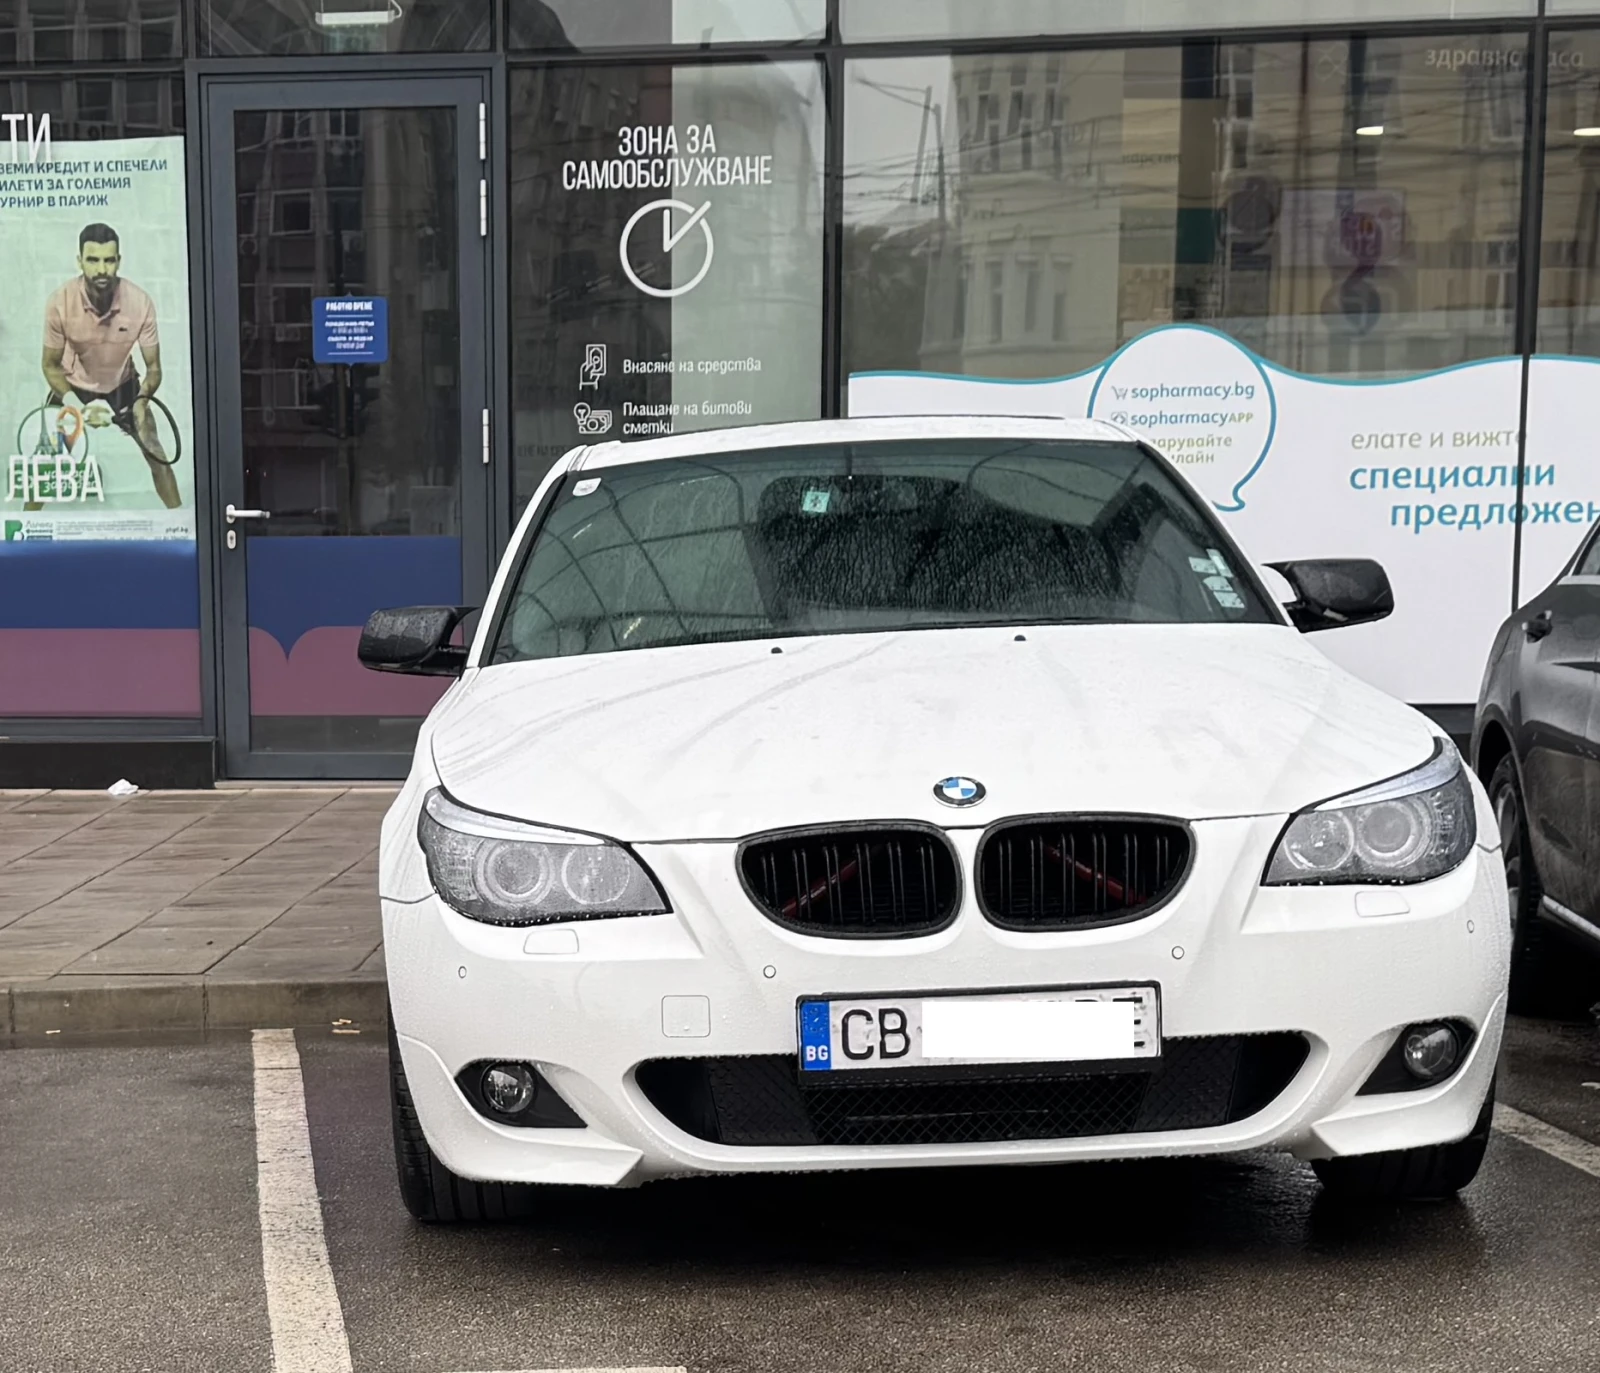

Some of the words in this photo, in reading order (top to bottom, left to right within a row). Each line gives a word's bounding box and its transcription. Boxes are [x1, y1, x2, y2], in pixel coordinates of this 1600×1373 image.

[618, 125, 678, 156] ЗОНА
[686, 124, 716, 154] ЗА
[37, 161, 89, 176] КРЕДИТ
[94, 161, 103, 172] И
[106, 159, 168, 172] СПЕЧЕЛИ
[562, 155, 772, 190] САМООБСЛУЖВАНЕ
[47, 178, 64, 190] ЗА
[67, 177, 131, 190] ГОЛЕМИЯ
[47, 196, 56, 207] В
[59, 195, 108, 207] ПАРИЖ
[623, 358, 675, 374] Внасяне
[679, 360, 694, 371] на
[697, 357, 762, 375] средства
[1131, 381, 1255, 401] sopharmacy.bg
[623, 401, 680, 416] Плащане
[683, 403, 698, 415] на
[701, 400, 752, 415] битови
[623, 419, 674, 434] сметки
[1351, 431, 1422, 449] елате
[1430, 432, 1443, 447] и
[1171, 451, 1214, 464] лайн
[4, 454, 105, 502] ЛЕВА
[1350, 464, 1555, 494] специални
[841, 1007, 910, 1060] CB
[806, 1045, 828, 1061] BG
